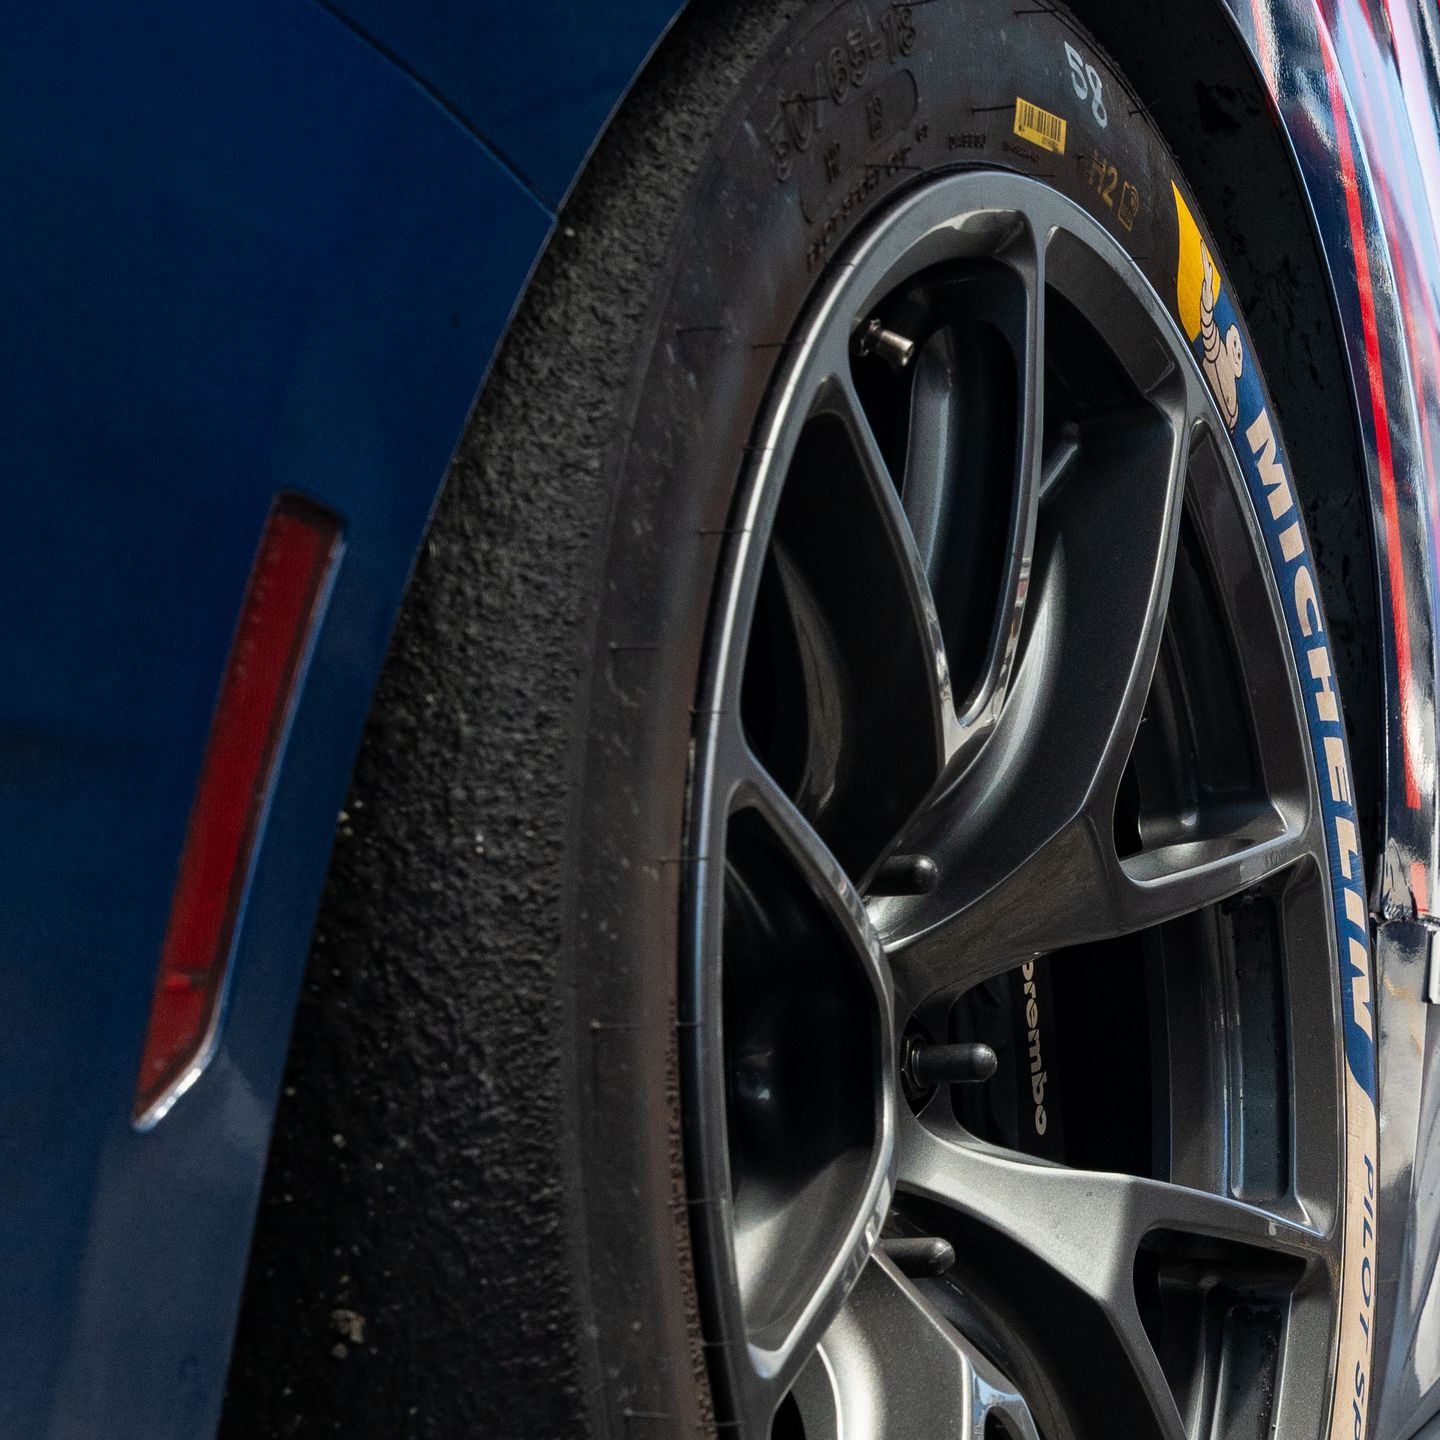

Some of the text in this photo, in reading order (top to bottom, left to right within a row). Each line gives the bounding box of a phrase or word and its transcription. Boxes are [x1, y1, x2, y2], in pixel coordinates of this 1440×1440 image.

[1064, 41, 1108, 129] 58
[1245, 421, 1374, 1046] MICHELIN
[1359, 1153, 1376, 1357] PILOT
